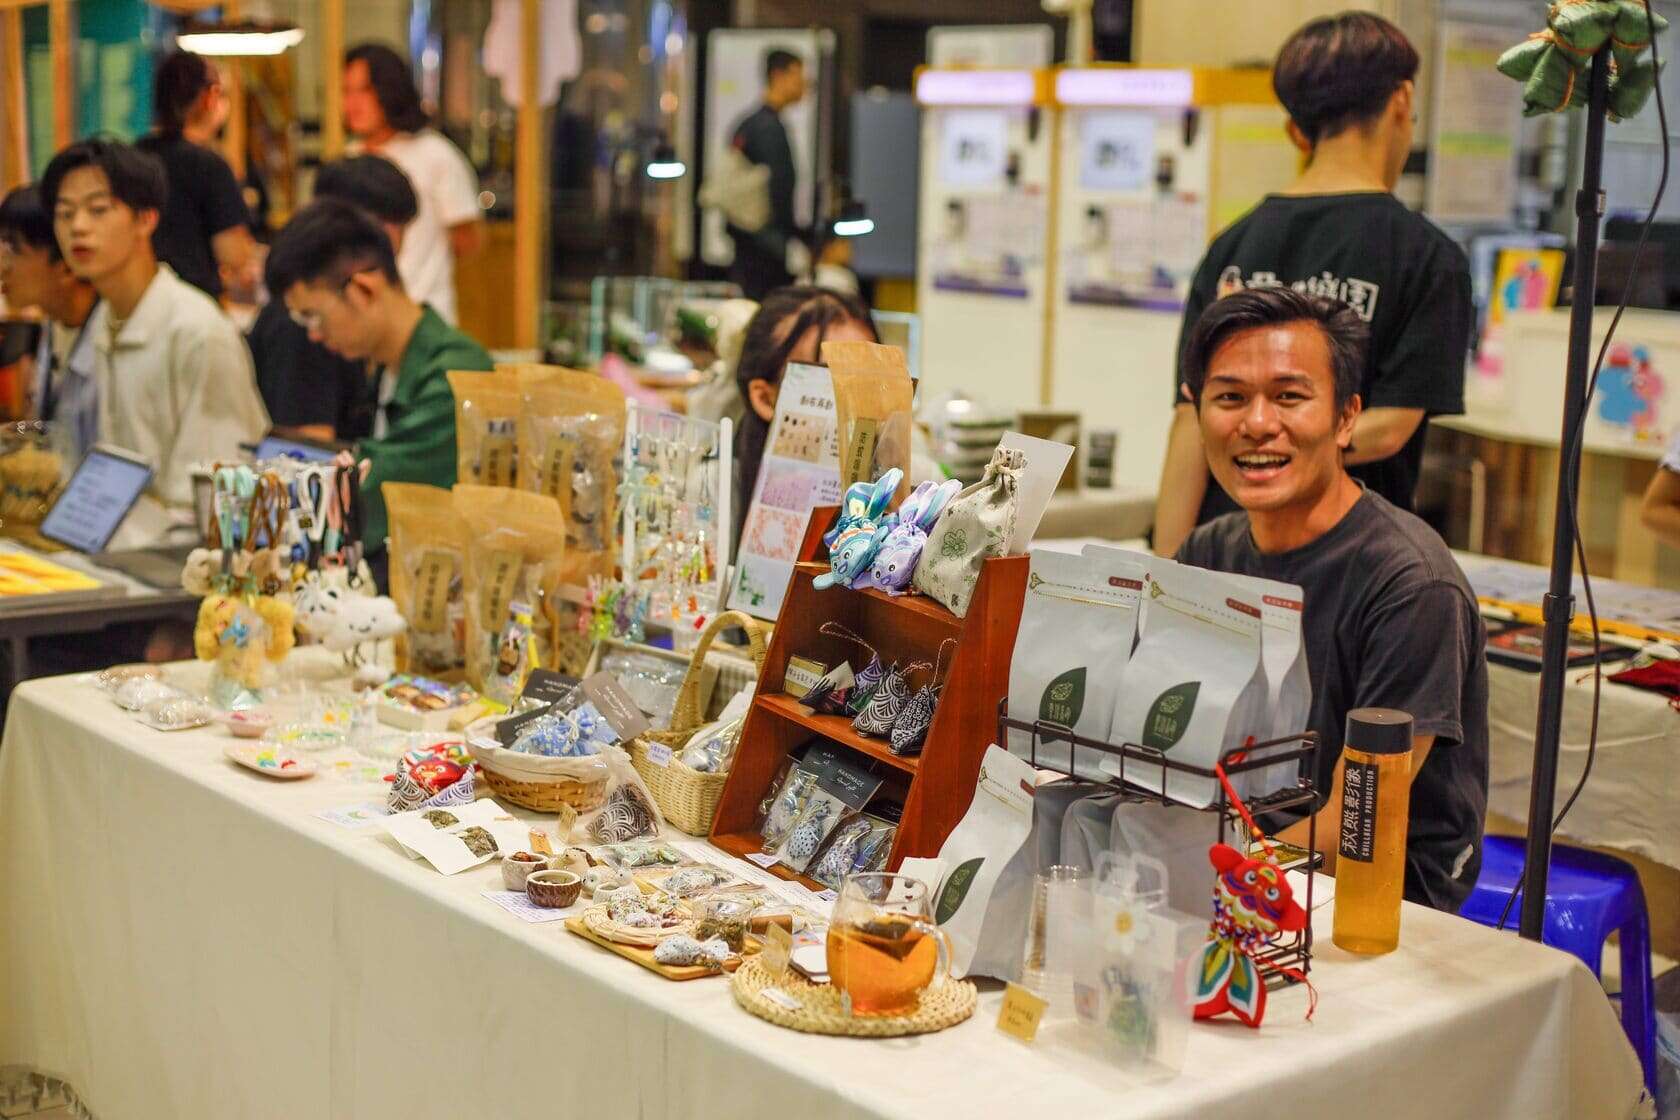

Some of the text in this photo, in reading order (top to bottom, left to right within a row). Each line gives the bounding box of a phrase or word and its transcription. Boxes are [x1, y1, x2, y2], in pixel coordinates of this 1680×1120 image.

[1341, 768, 1362, 855] 秋熊影像
[1361, 769, 1375, 857] CHILLBEAR PRODUCTION
